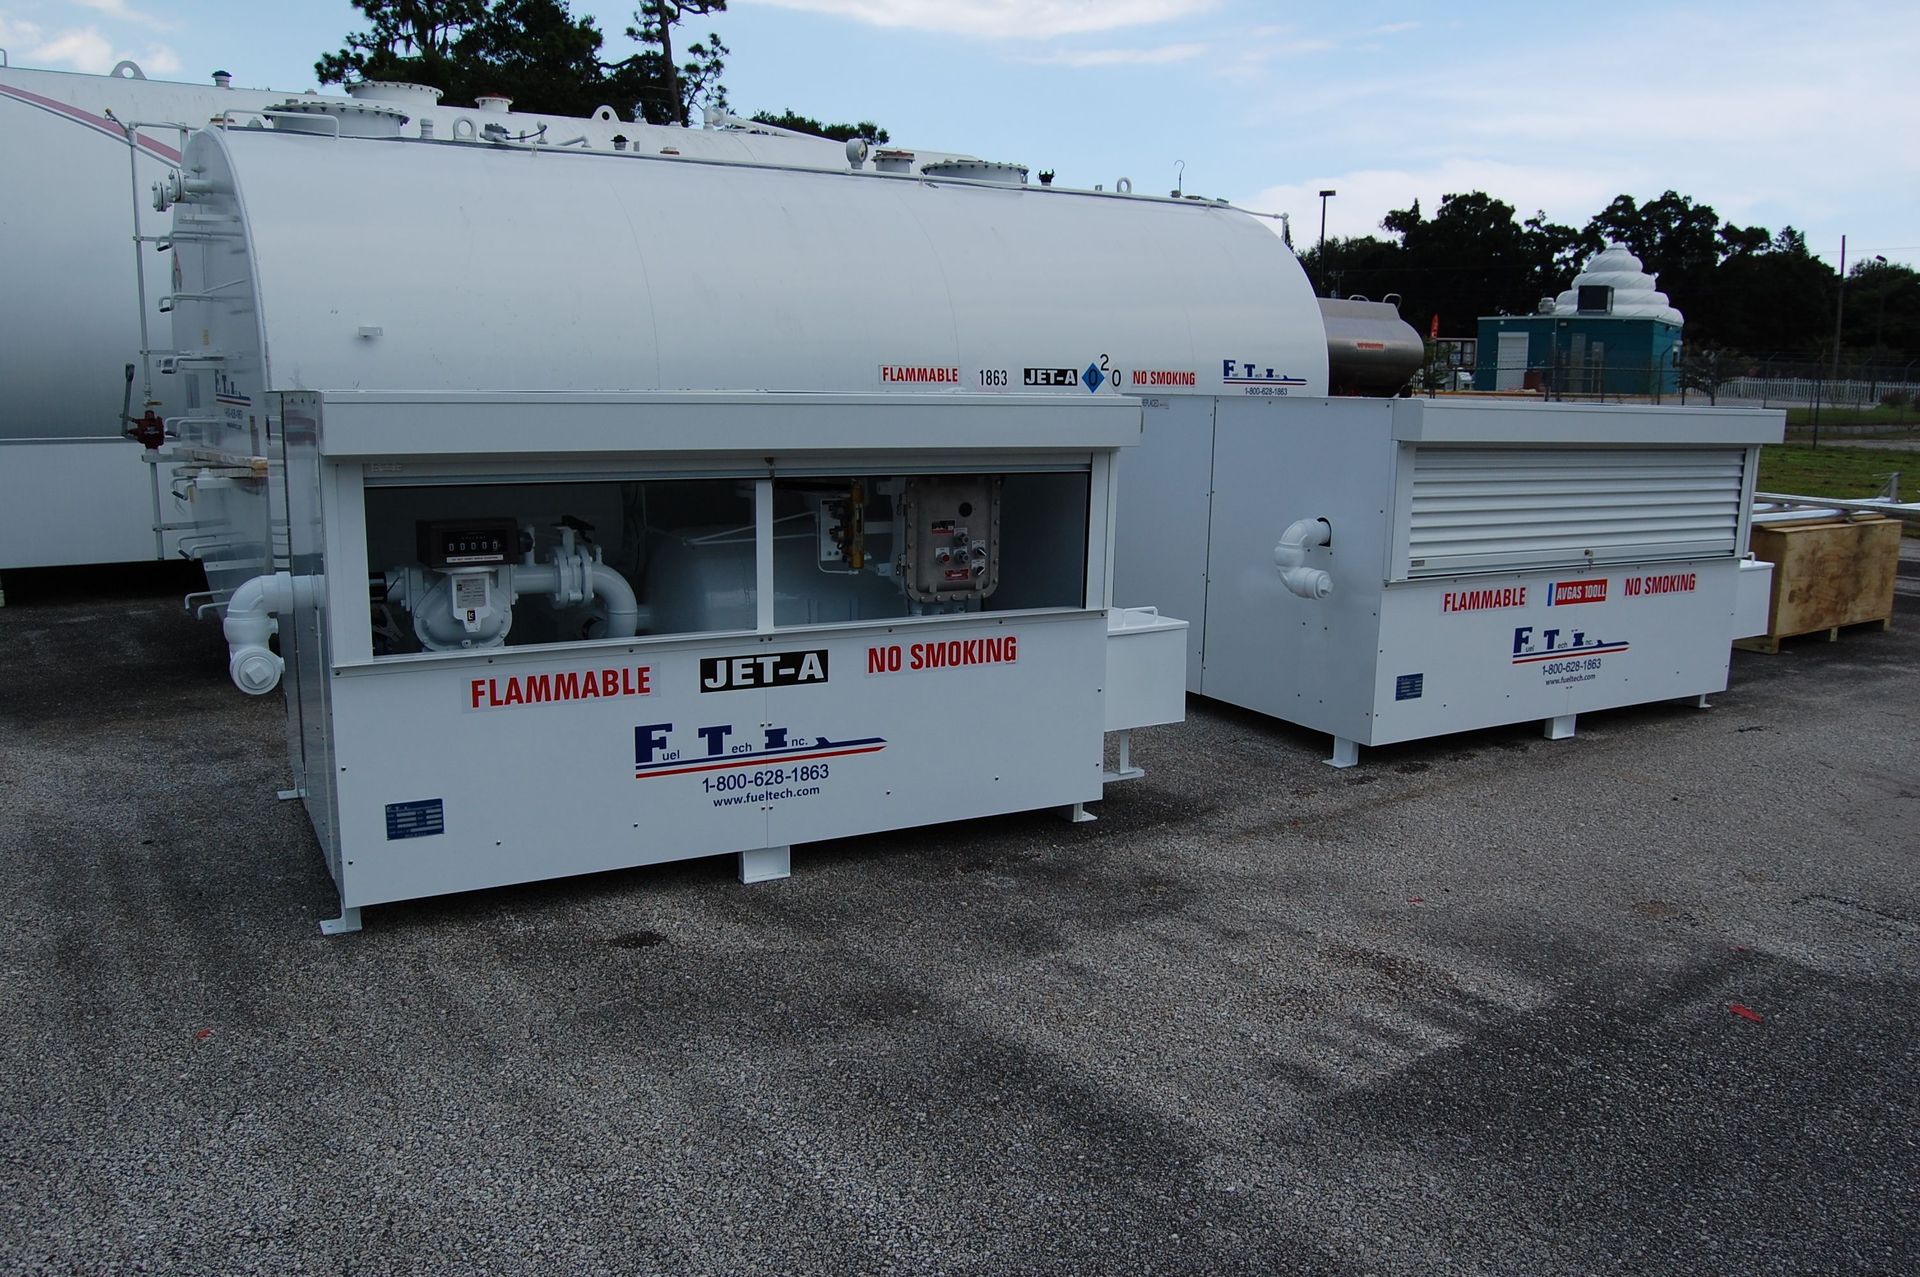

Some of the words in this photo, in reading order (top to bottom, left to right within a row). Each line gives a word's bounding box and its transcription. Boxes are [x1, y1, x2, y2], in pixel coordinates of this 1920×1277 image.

[1100, 353, 1109, 371] 2
[882, 367, 958, 382] FLAMMABLE
[979, 369, 1008, 386] 1863
[1025, 369, 1076, 384] JET-A
[1088, 369, 1099, 386] 0
[1111, 369, 1122, 387] 0
[1133, 370, 1147, 385] NO
[1150, 371, 1196, 386] SMOKING
[1244, 387, 1288, 396] 1-800-628-1863
[1556, 585, 1582, 601] AVGAS
[1584, 584, 1606, 599] 100LL
[1624, 578, 1642, 596] NO
[1644, 573, 1696, 595] SMOKING
[1443, 587, 1527, 612] FLAMMABLE
[867, 644, 902, 674] NO
[910, 636, 1017, 671] SMOKING
[704, 652, 825, 690] JET-A
[1542, 658, 1602, 676] 1-800-628-1863
[471, 666, 651, 708] FLAMMABLE
[1545, 673, 1596, 686] www.fueltech.com
[635, 723, 681, 763] Fuel
[698, 724, 752, 755] Tech
[701, 764, 830, 793] 1-800-628-1863
[712, 785, 821, 807] www.fueltech.com
